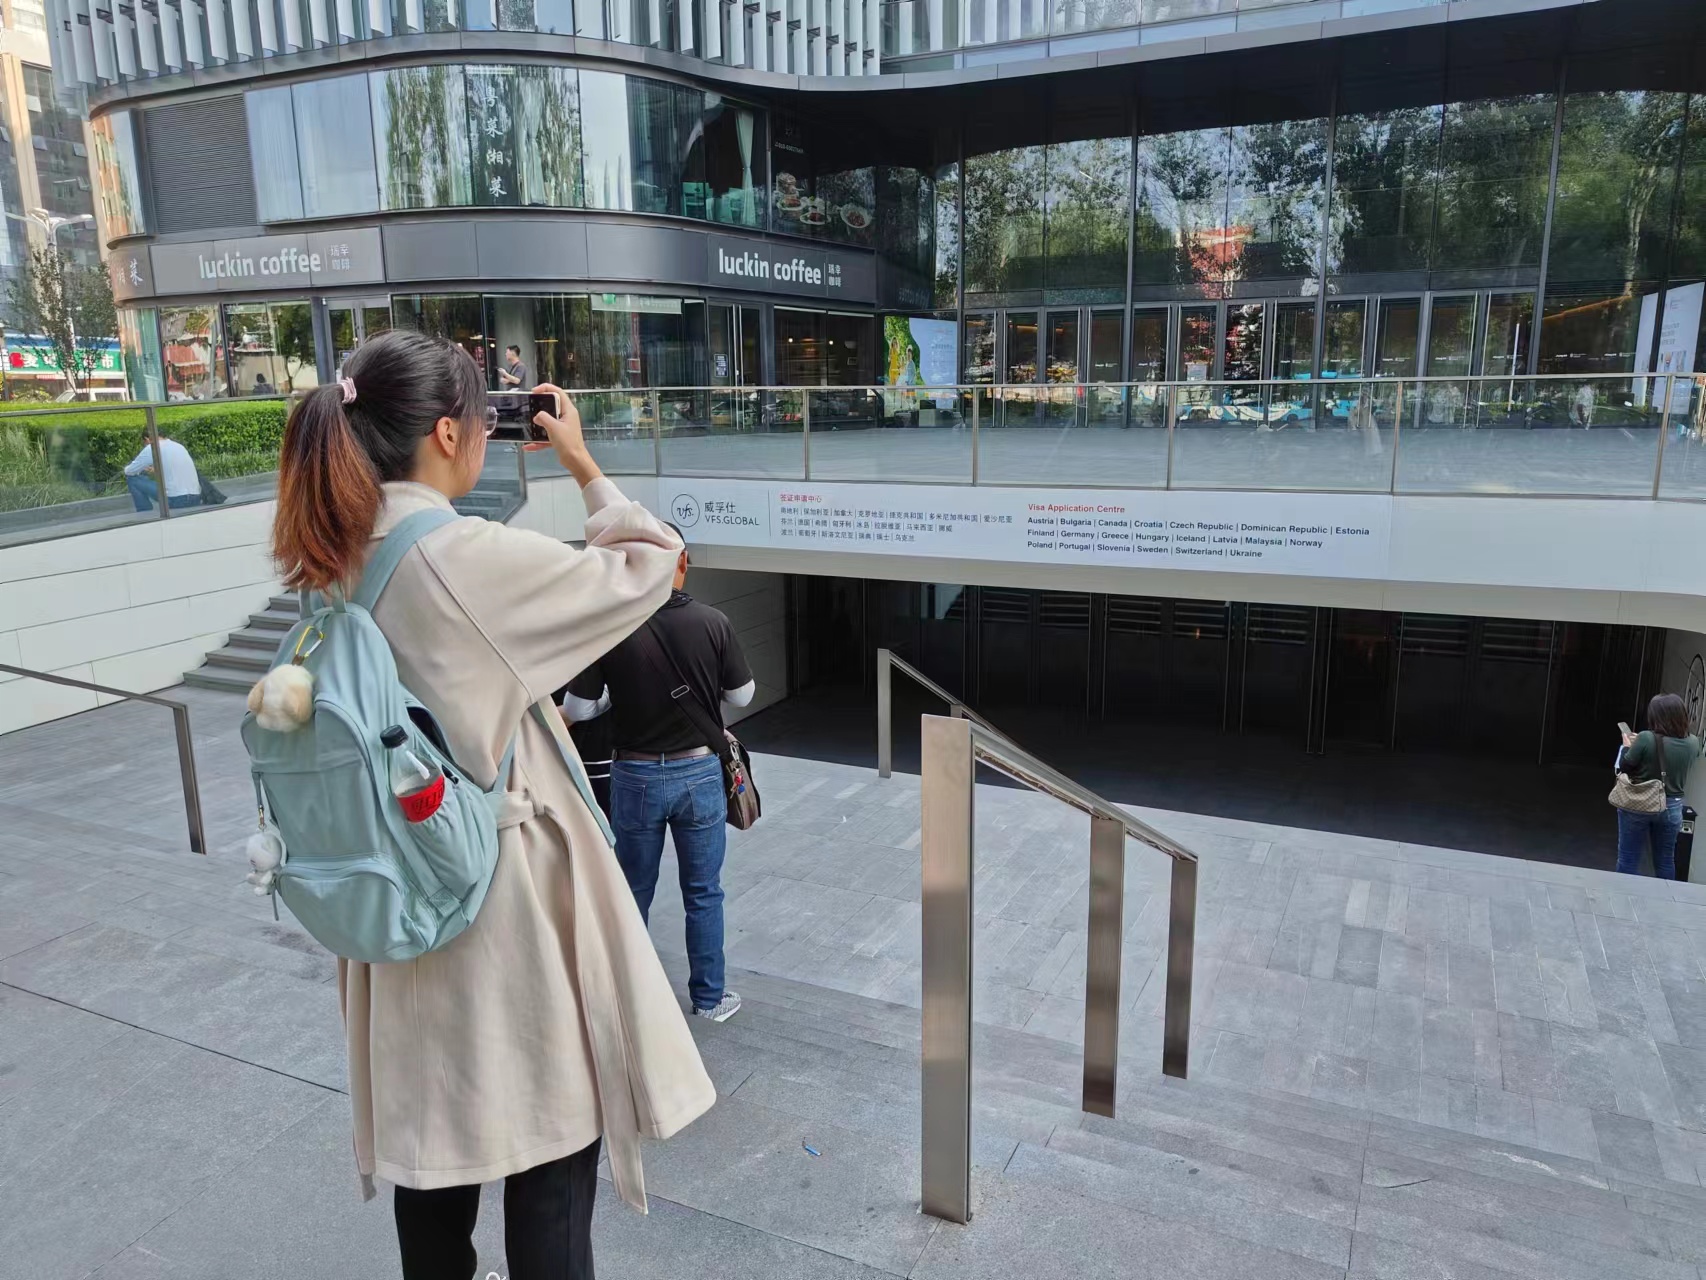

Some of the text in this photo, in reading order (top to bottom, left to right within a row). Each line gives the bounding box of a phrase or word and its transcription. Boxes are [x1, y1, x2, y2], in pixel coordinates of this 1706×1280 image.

[483, 86, 507, 197] 粤菜湘菜
[330, 244, 349, 257] 瑞幸
[199, 247, 321, 279] luckin coffee
[331, 258, 351, 271] 咖啡
[719, 248, 822, 285] luckin coffee
[828, 263, 841, 275] 瑞幸
[828, 276, 842, 287] 咖啡
[780, 494, 822, 503] 签证申请中心
[704, 502, 736, 514] 威孚仕
[1048, 504, 1094, 513] Application
[1097, 505, 1125, 513] Centre
[705, 515, 760, 526] VFS.GLOBAL
[1028, 517, 1054, 525] Austria
[1060, 518, 1092, 526] Bulgaria
[1098, 519, 1128, 527] Canada
[1134, 520, 1163, 528] Croatia
[1197, 522, 1234, 531] Republic
[1241, 523, 1287, 533] Dominican
[1289, 525, 1328, 535] Republic
[1335, 527, 1370, 536] Estonia
[1027, 529, 1323, 548] Finland Germany Greece Hungary Iceland Latvia Malaysia Norway
[1027, 541, 1263, 558] Poland Portugal Slovenia Sweden Switzerland Ukraine
